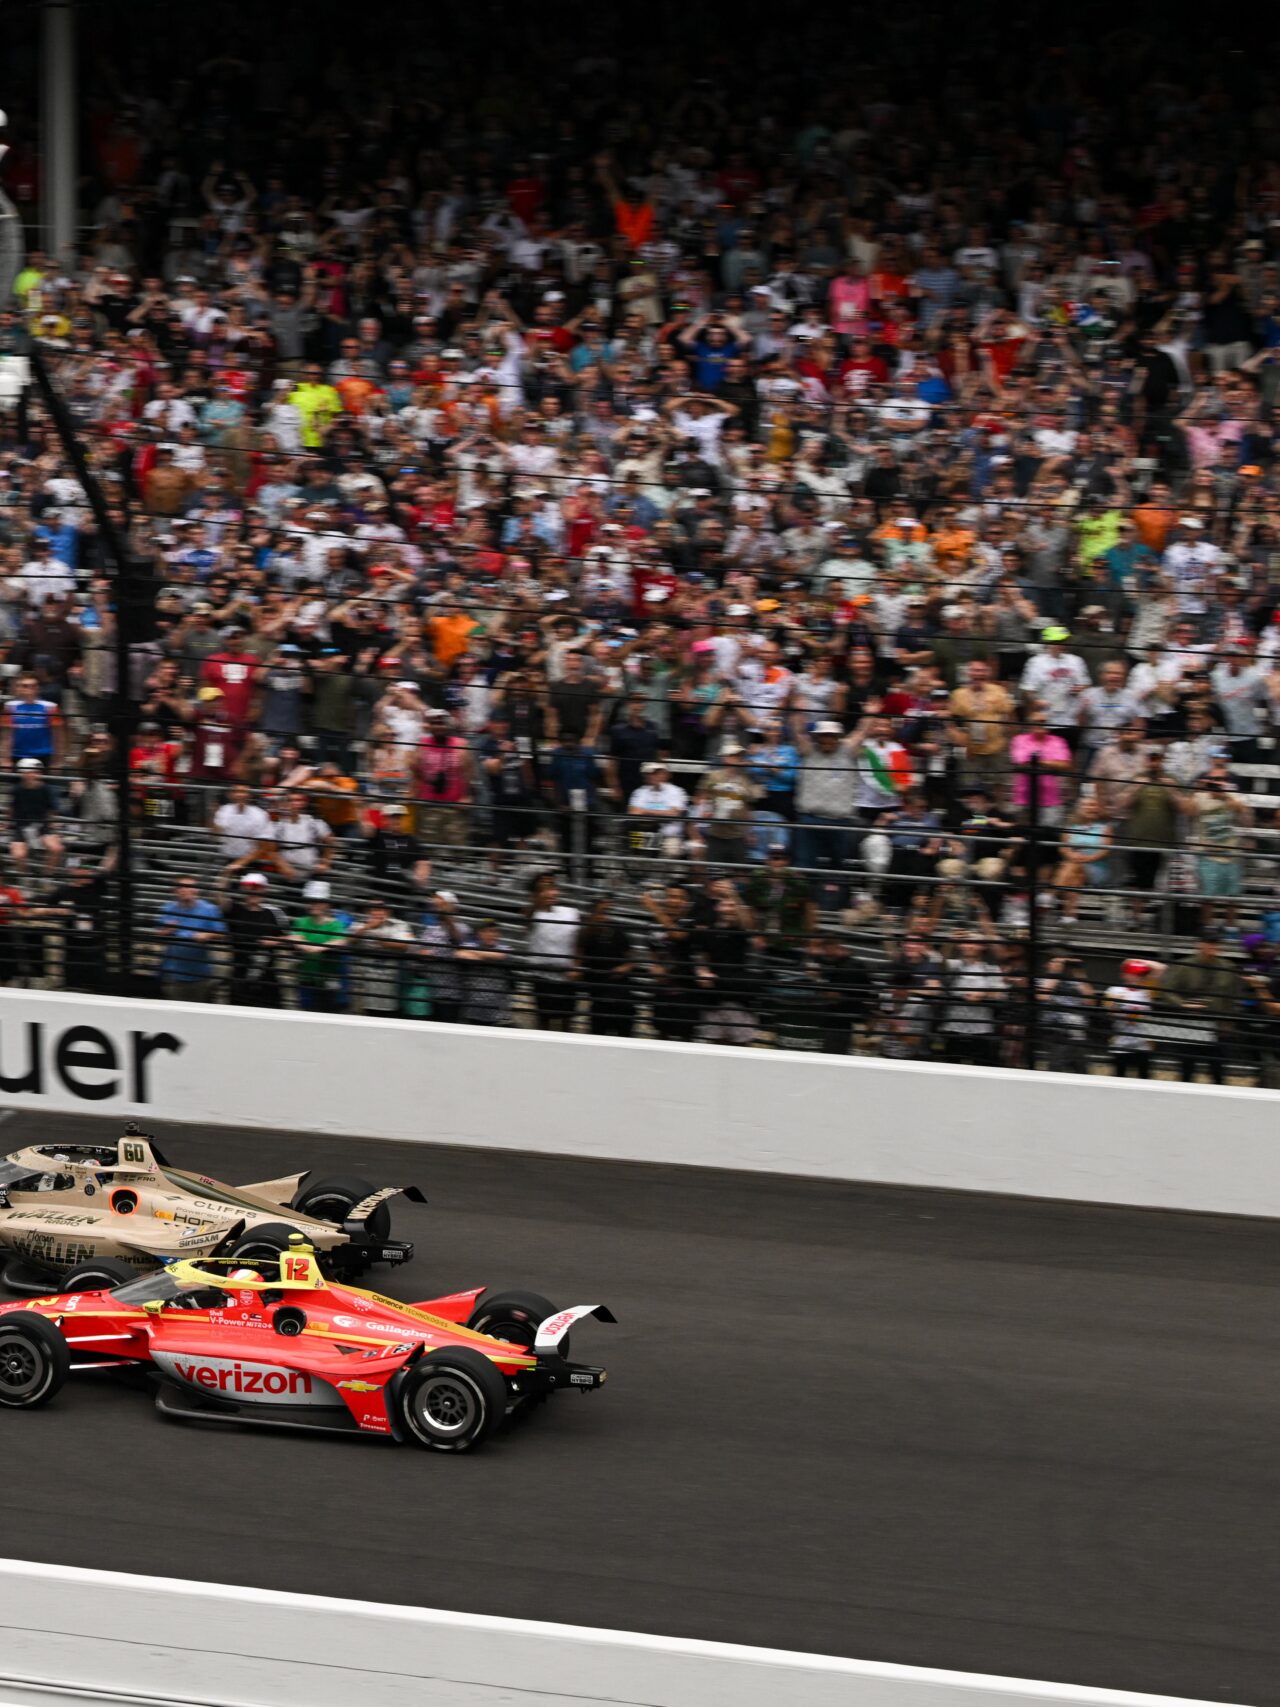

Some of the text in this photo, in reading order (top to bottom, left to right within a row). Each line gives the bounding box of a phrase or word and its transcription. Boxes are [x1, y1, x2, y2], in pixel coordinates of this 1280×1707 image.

[123, 1143, 145, 1163] 60
[194, 1200, 257, 1219] CLIFFS
[179, 1234, 219, 1248] SiriusXM
[285, 1258, 310, 1281] 12
[209, 1309, 223, 1317] Shell
[210, 1317, 249, 1327] V-Power
[366, 1321, 434, 1340] Gallagher
[174, 1363, 312, 1394] verizon
